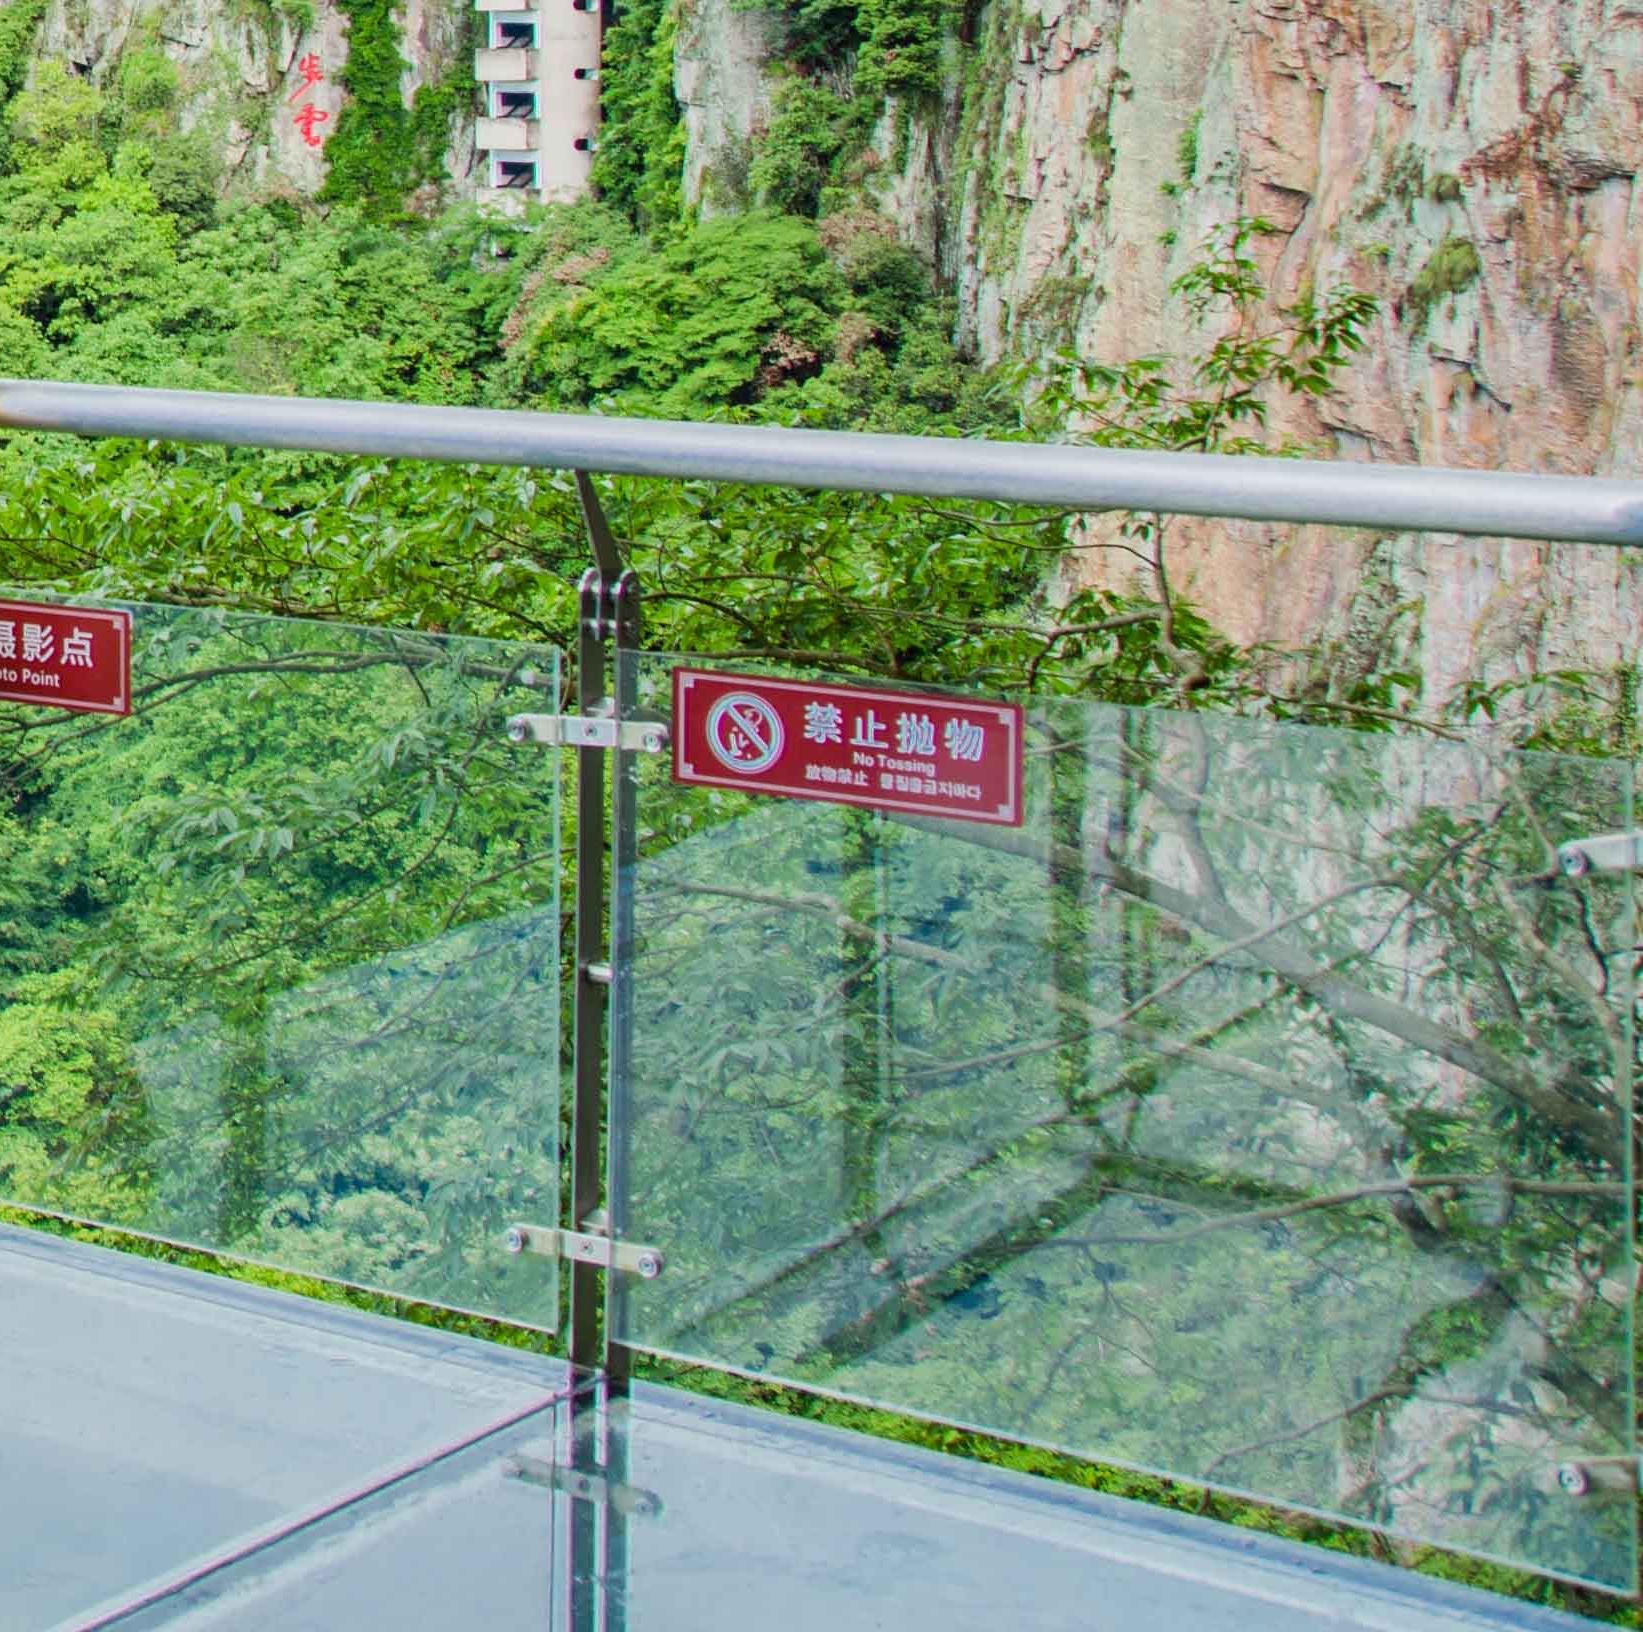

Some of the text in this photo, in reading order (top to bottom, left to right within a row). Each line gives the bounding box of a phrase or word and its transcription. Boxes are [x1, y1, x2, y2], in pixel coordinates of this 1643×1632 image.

[22, 669, 60, 688] Point
[803, 701, 985, 761] 禁止抛物
[853, 751, 936, 777] No Tossing
